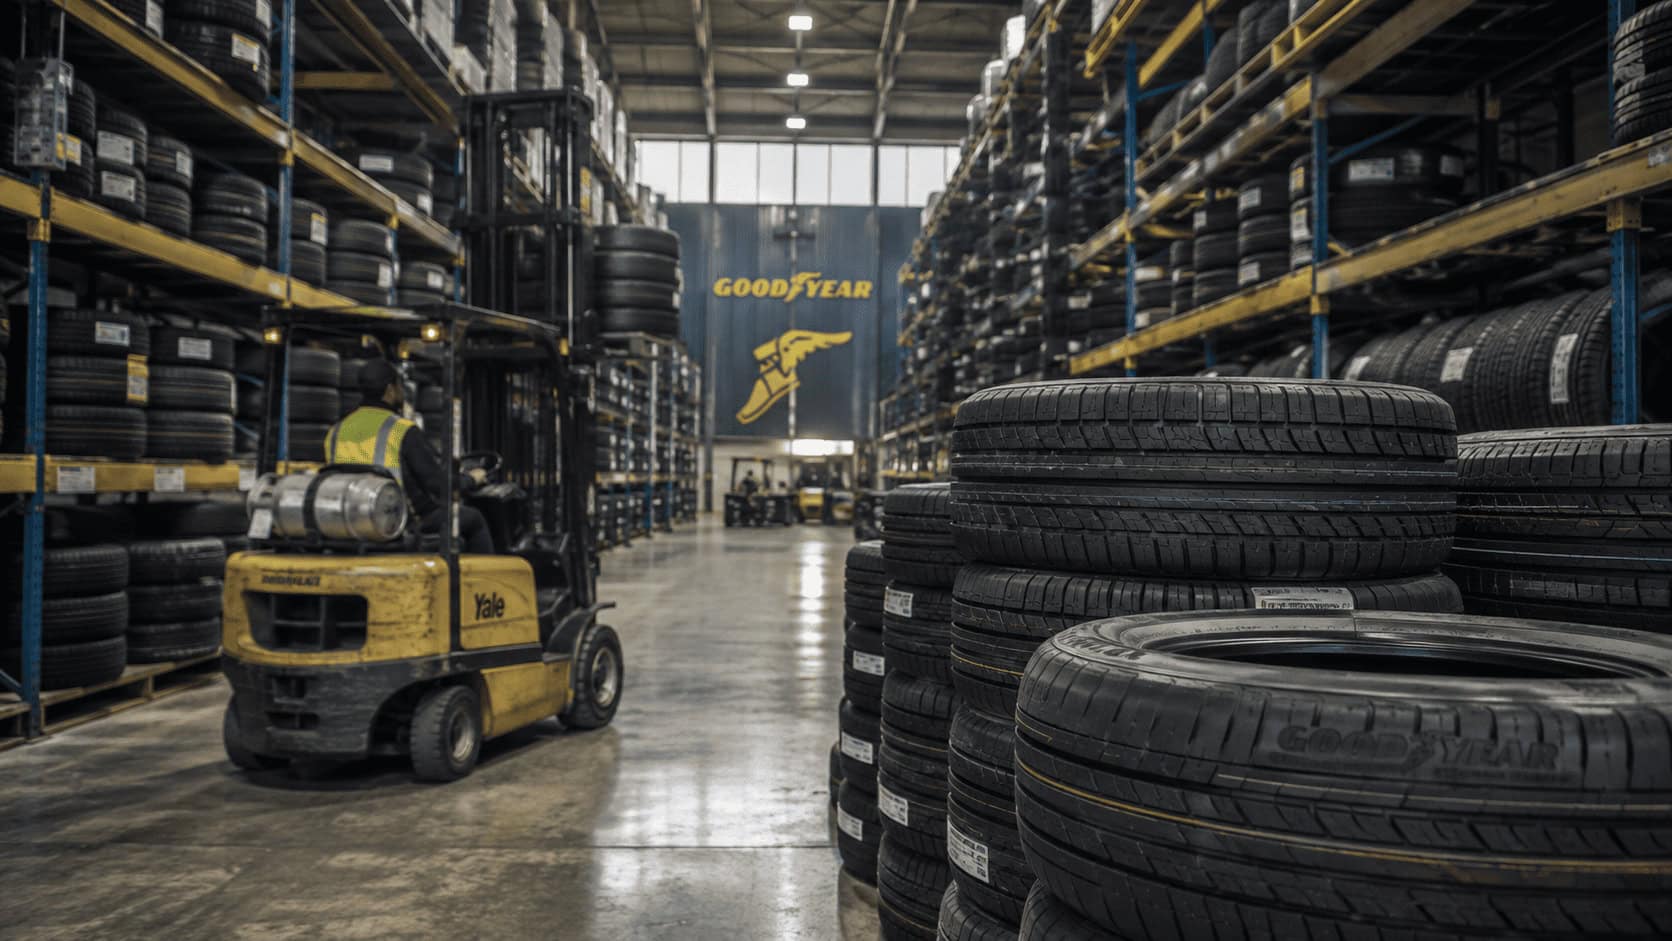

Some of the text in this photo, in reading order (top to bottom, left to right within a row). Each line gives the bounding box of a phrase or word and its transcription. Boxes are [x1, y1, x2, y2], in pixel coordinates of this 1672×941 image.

[712, 272, 874, 302] GOODYEAR
[473, 591, 505, 621] Yale
[1277, 725, 1560, 771] GOODYEAR
